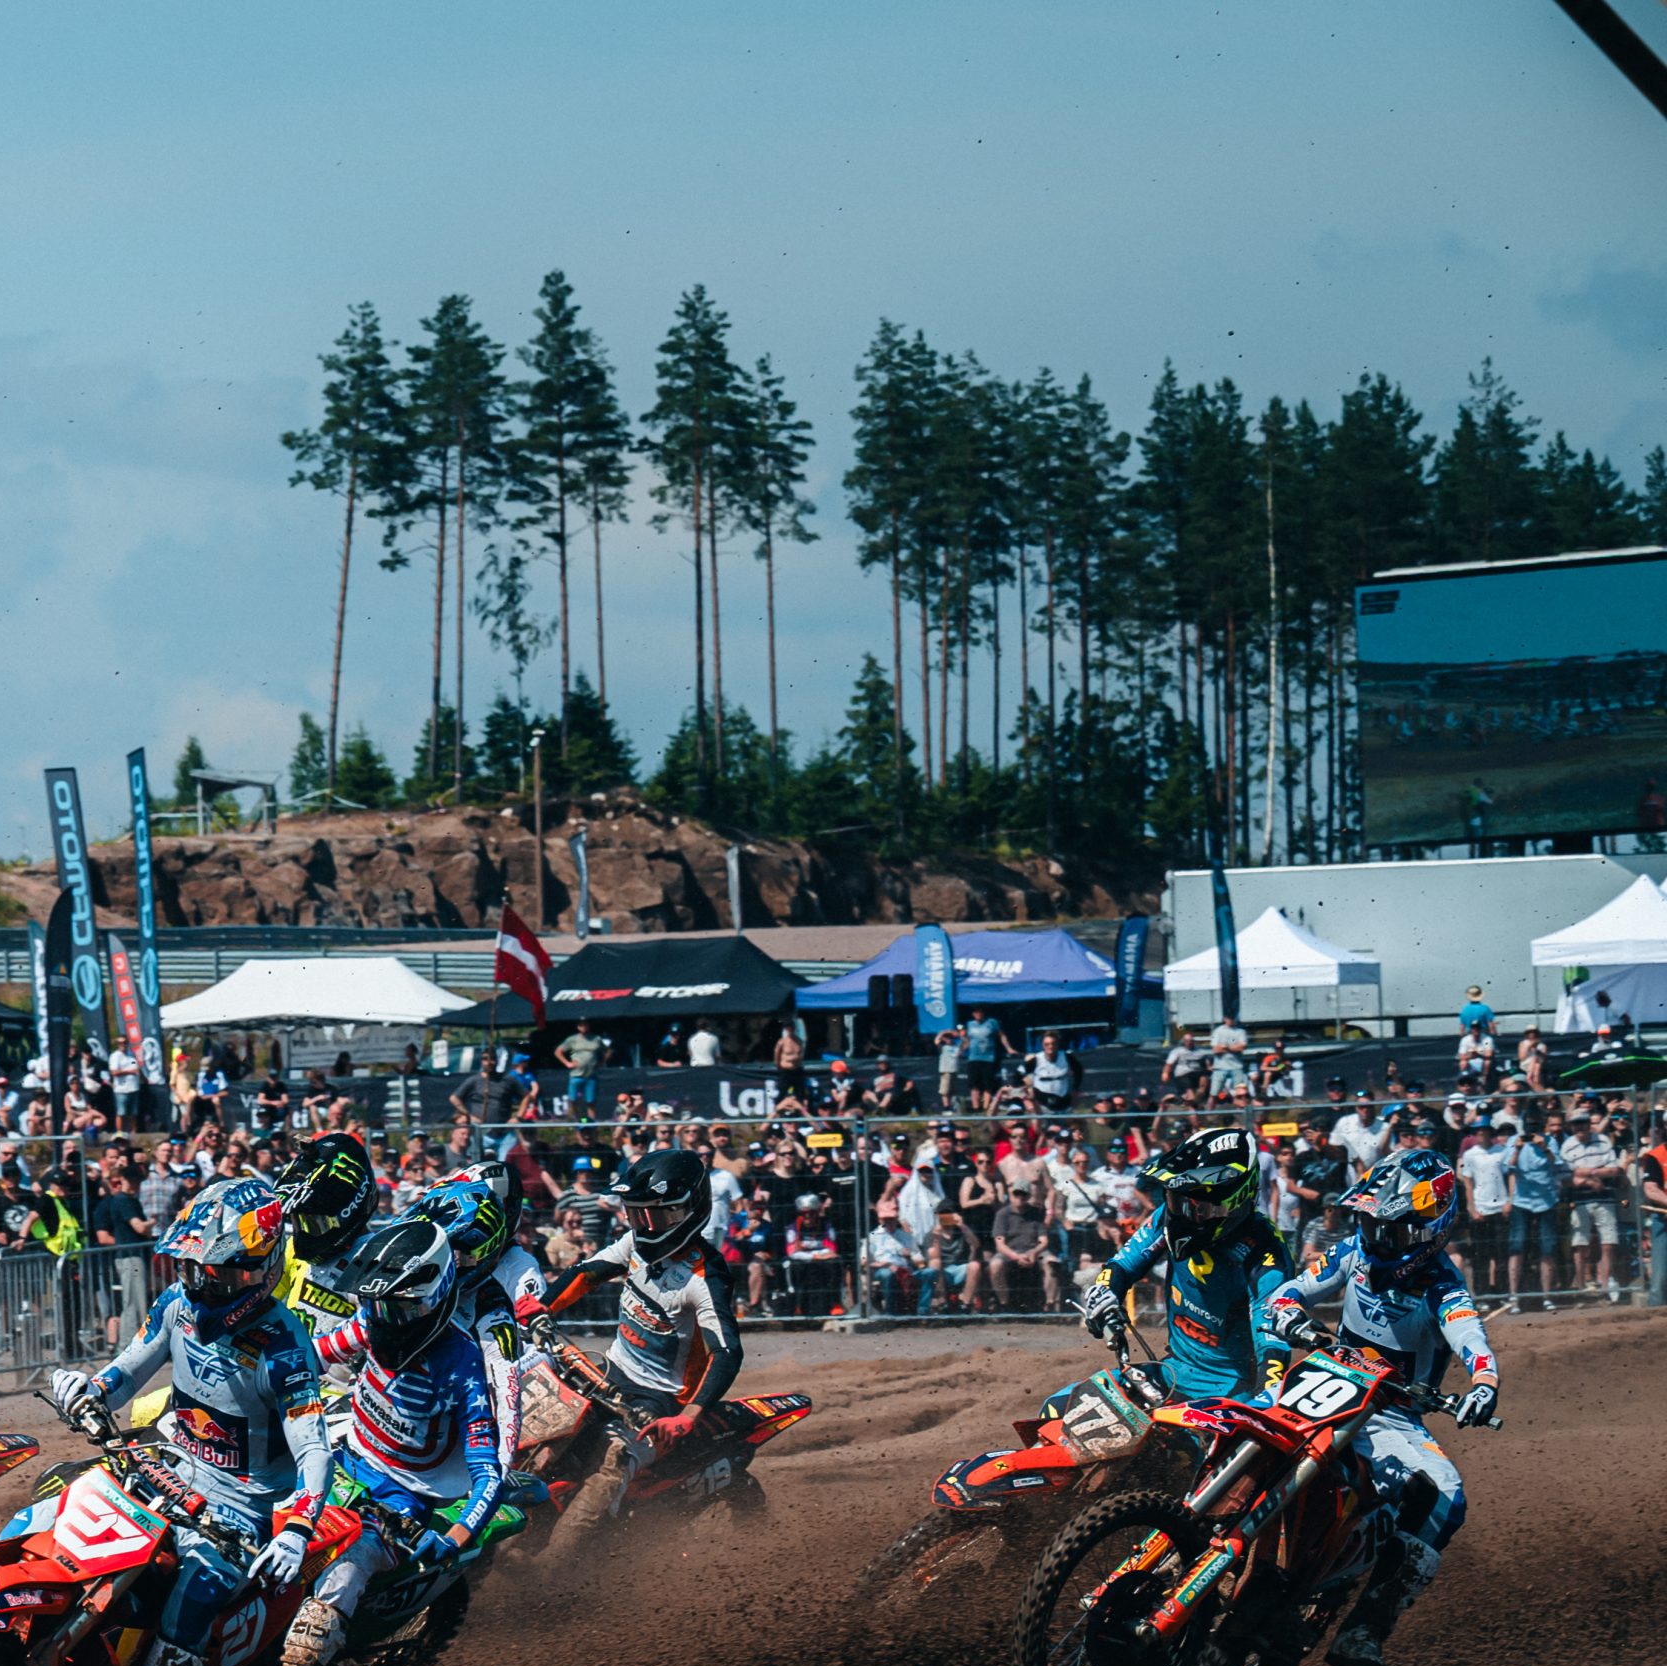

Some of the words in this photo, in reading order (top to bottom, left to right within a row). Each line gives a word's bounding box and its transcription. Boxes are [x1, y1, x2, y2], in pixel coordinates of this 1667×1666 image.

[340, 1181, 370, 1218] OAKLEY
[1382, 1200, 1408, 1216] AIROH
[305, 1283, 355, 1316] THOR
[1183, 1299, 1224, 1327] venrooy
[1317, 1357, 1351, 1378] MOTOREX
[1279, 1371, 1358, 1417] 19
[359, 1386, 416, 1437] Kawasaki
[1063, 1393, 1132, 1457] 172
[1281, 1414, 1302, 1425] KTM
[381, 1422, 403, 1442] Team
[201, 1446, 239, 1469] Bull
[938, 1484, 964, 1506] KTM
[466, 1502, 487, 1529] BUD
[57, 1555, 79, 1574] KTM
[1194, 1553, 1231, 1592] MOTOREX
